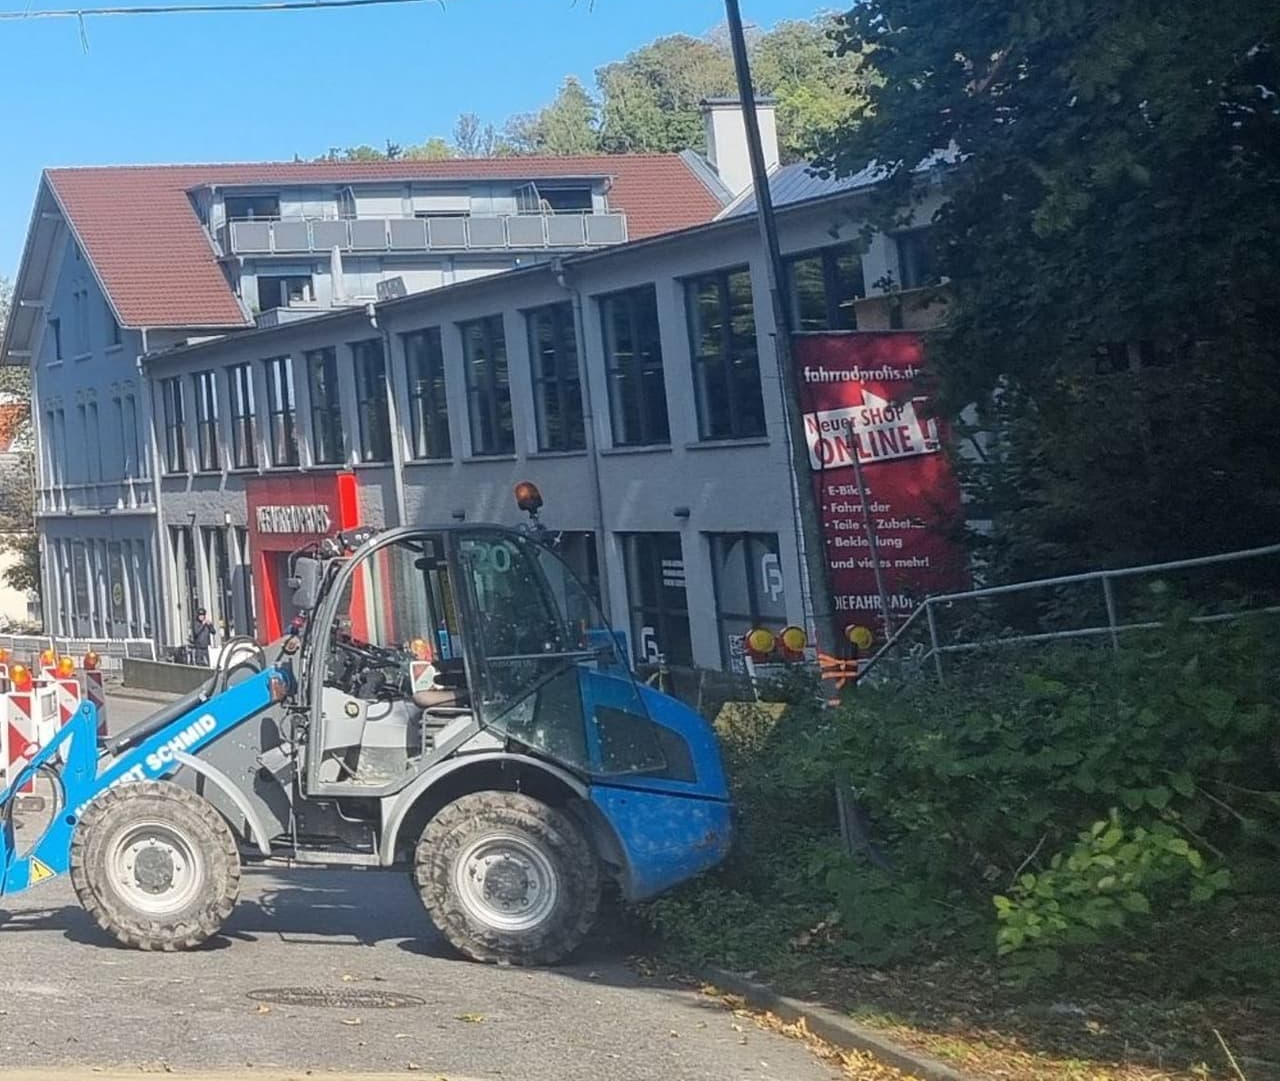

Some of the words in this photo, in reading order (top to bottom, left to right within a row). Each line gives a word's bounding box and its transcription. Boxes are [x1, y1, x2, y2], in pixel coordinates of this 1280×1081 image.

[806, 415, 856, 435] Neuer
[861, 405, 904, 426] SHOP
[814, 425, 914, 465] ONLINE
[827, 485, 872, 496] E-Biks
[831, 501, 891, 513] Fahrrder
[832, 520, 860, 530] Teile
[834, 536, 903, 548] Bekleung
[831, 558, 854, 569] und
[858, 558, 891, 569] viees
[145, 712, 217, 770] SCHMID
